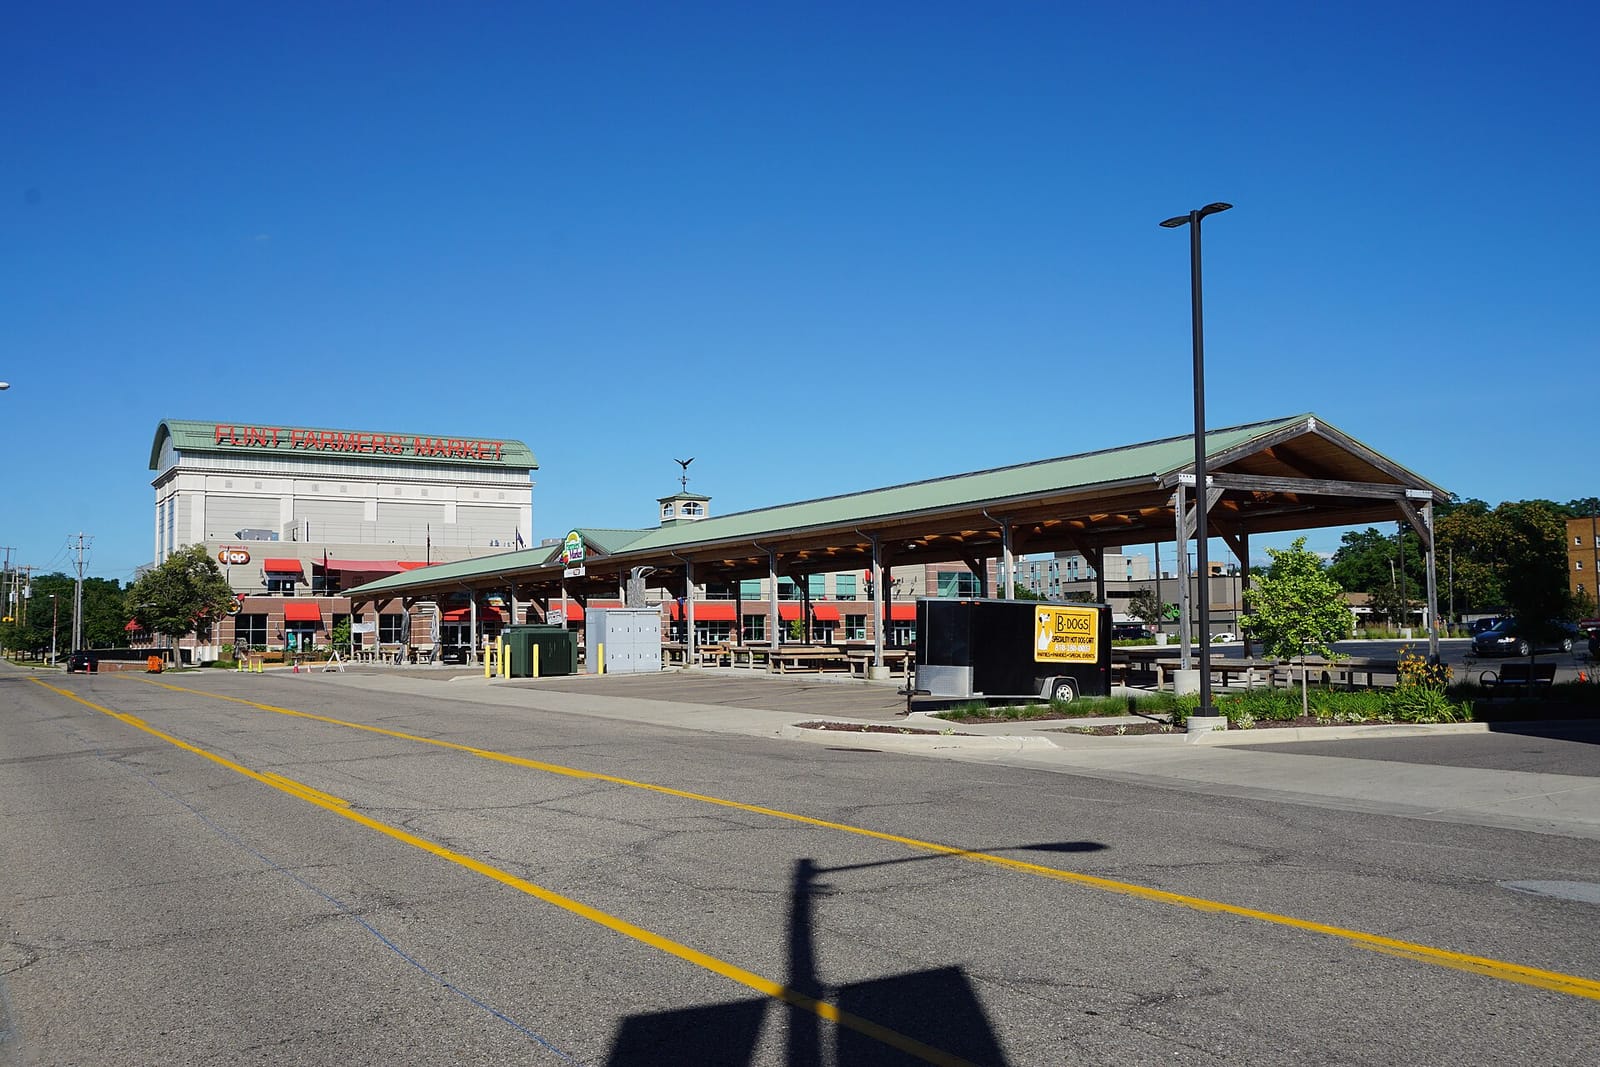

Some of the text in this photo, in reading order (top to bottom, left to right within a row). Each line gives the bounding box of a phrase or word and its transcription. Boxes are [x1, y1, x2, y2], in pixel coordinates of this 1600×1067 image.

[215, 425, 504, 461] FLINT FARMERS' MARKET
[1057, 615, 1089, 631] B-DOGS
